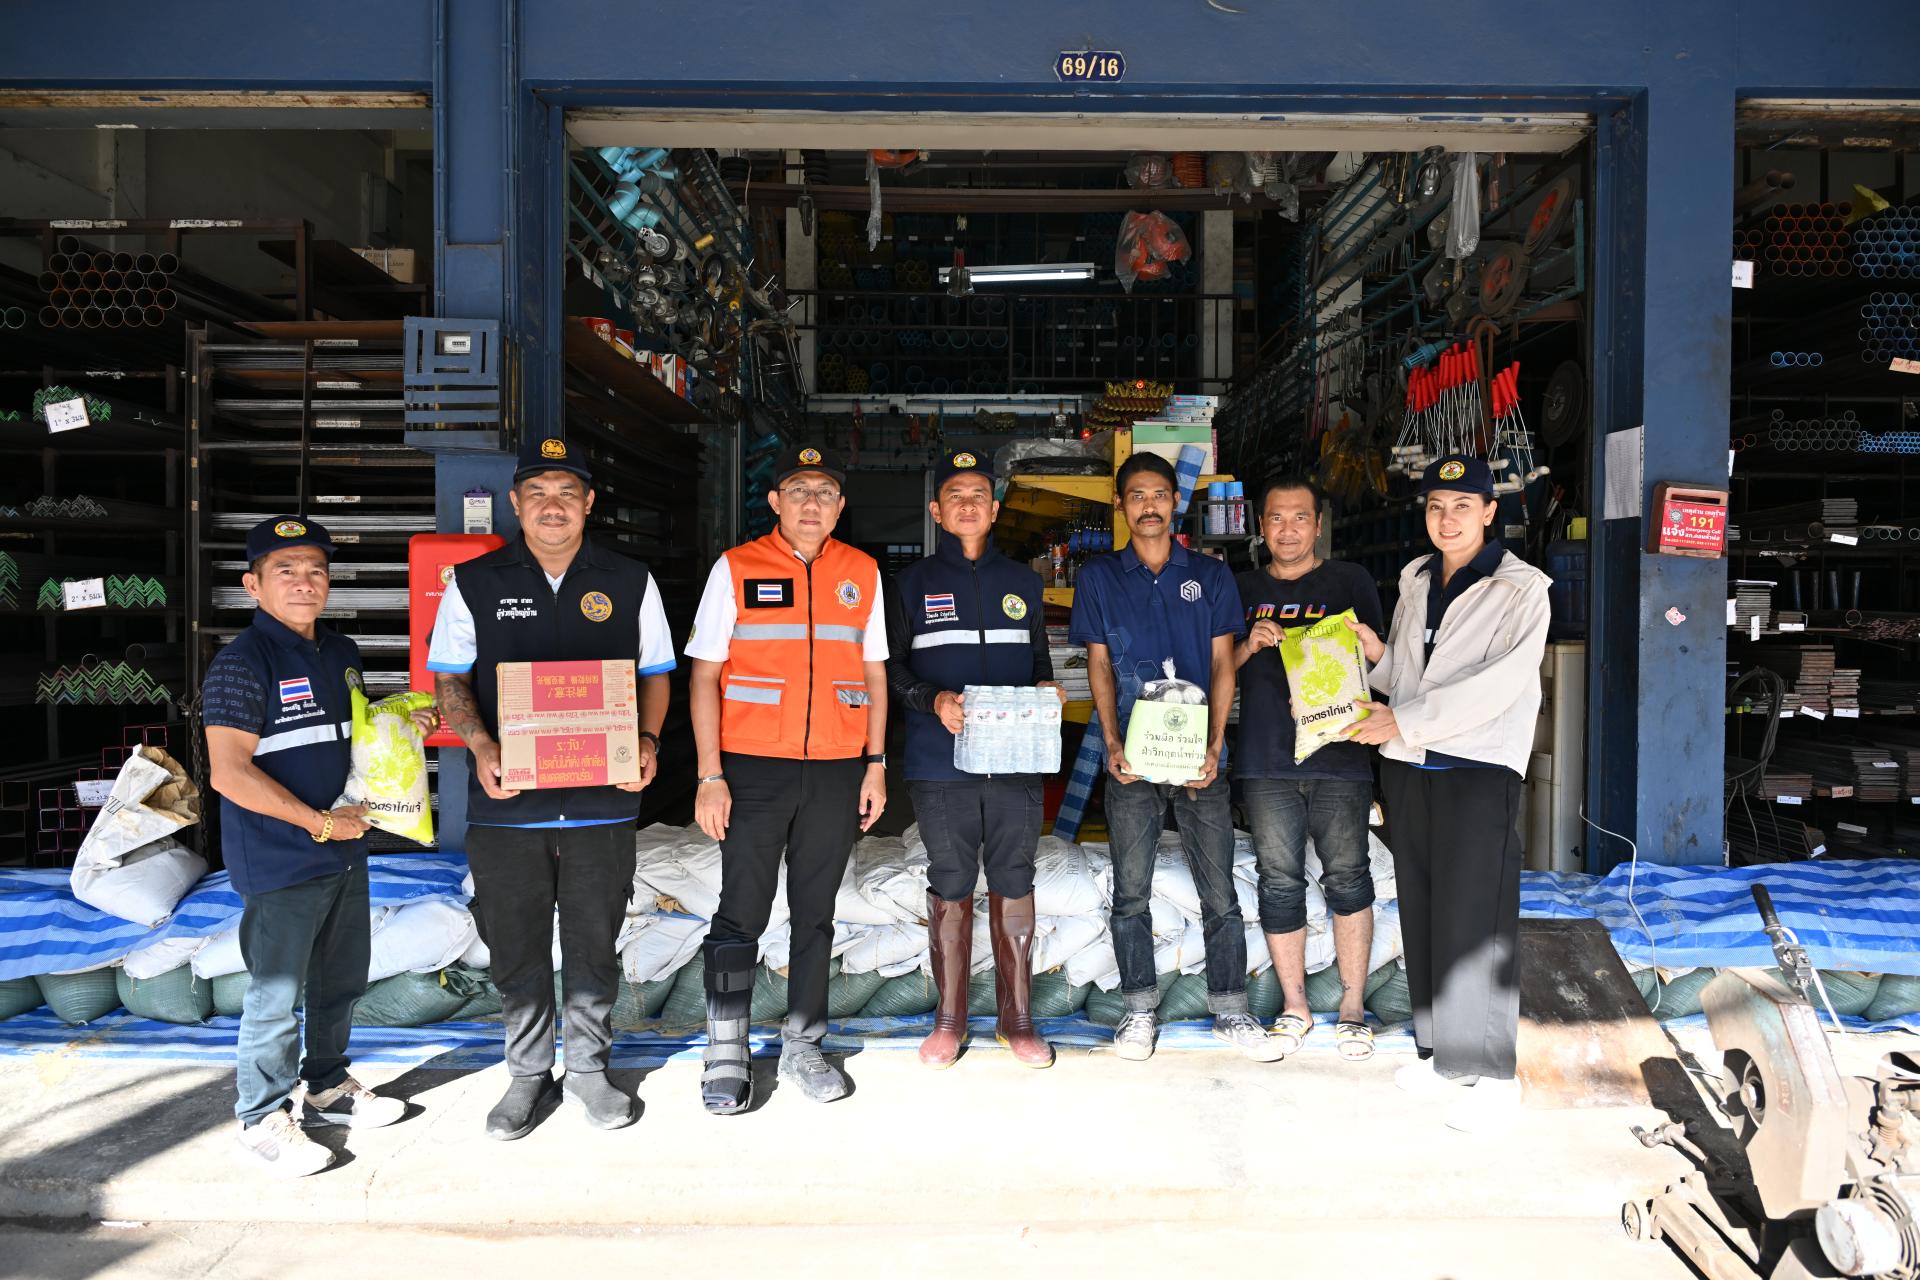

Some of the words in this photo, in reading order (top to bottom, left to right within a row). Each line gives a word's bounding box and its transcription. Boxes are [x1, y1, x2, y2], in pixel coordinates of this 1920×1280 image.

[1062, 55, 1119, 79] 69/16
[1662, 523, 1685, 537] แจ้ง
[1690, 516, 1715, 529] 191
[1301, 702, 1354, 726] ข้าวตราไก่แจ้
[1143, 730, 1174, 743] ร่วมมือ
[1177, 732, 1203, 745] ร่วมใจ
